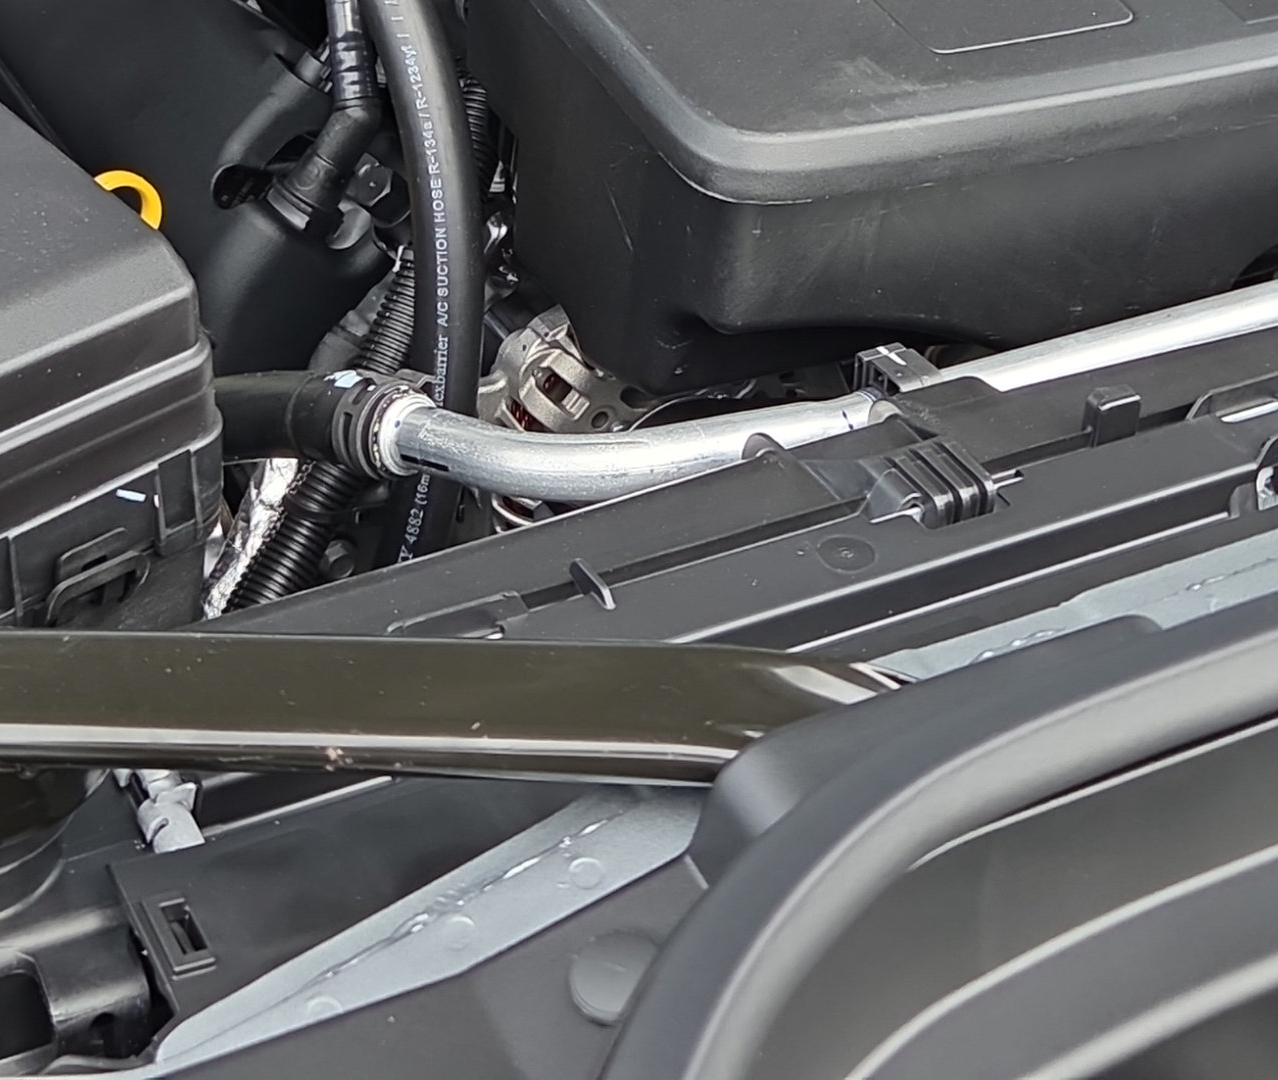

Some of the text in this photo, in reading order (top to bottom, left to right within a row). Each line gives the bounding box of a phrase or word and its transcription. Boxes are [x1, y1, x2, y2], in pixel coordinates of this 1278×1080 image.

[422, 120, 441, 175] R-134a
[430, 177, 446, 223] HOSE
[434, 228, 449, 296] SUCTION
[436, 301, 449, 327] A/C
[404, 508, 424, 544] 4882
[414, 473, 431, 505] (16m
